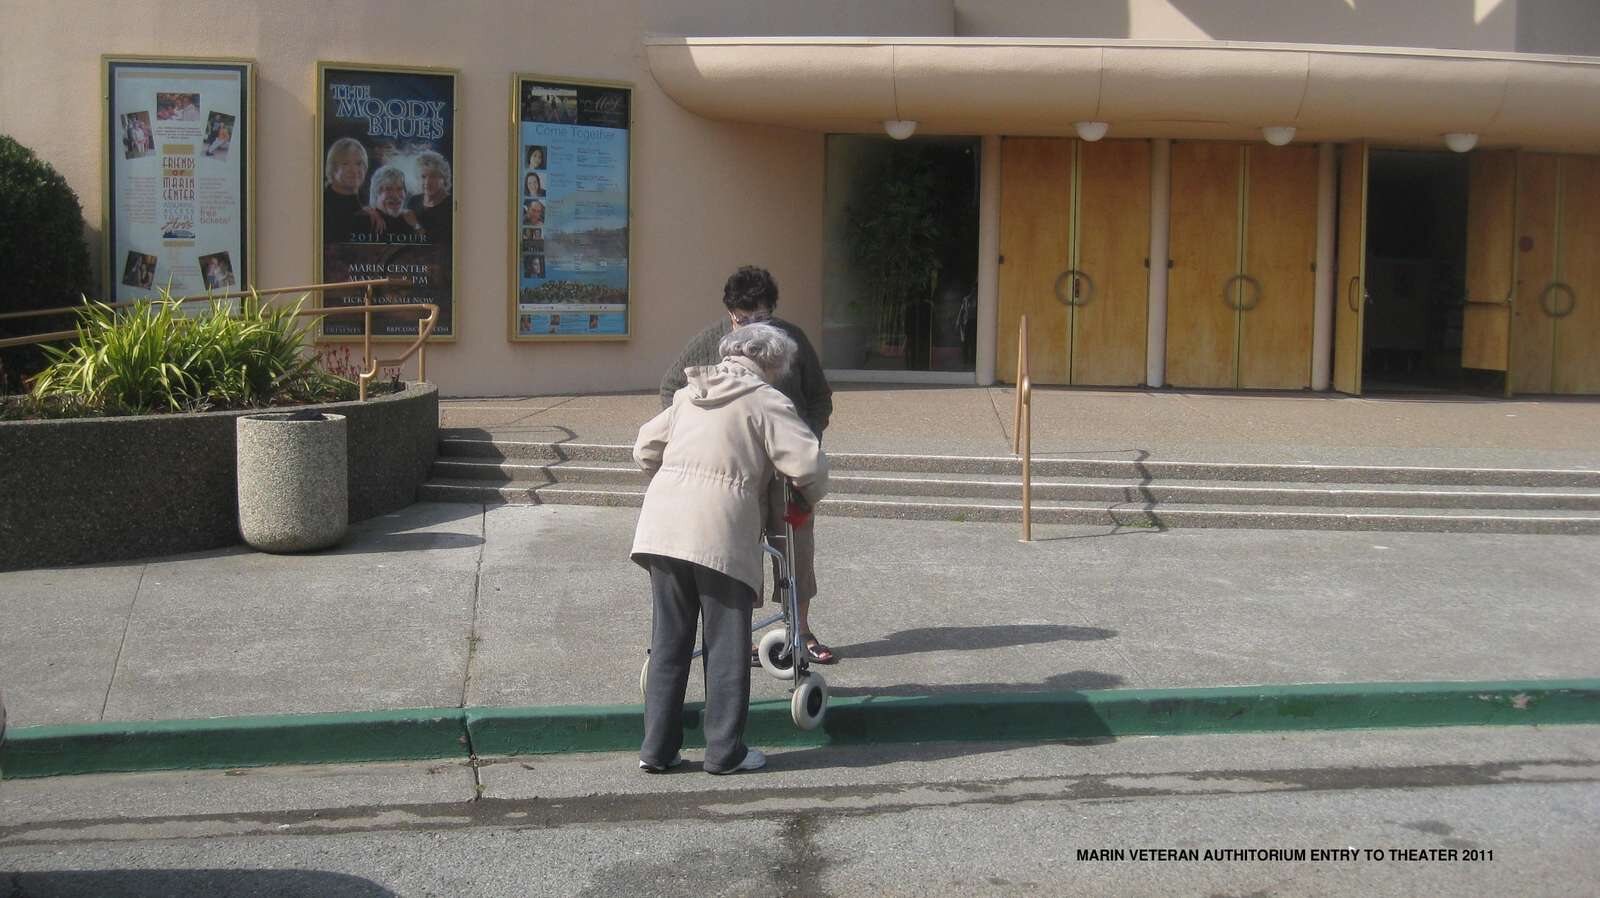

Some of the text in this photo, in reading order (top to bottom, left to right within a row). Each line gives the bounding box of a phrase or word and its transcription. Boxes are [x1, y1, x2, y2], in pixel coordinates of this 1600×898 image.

[330, 83, 371, 100] THE
[336, 98, 446, 120] MOODY
[367, 116, 445, 140] BLUES
[535, 124, 568, 136] Come
[162, 156, 196, 168] FRIENDS
[163, 176, 195, 188] MARIN
[162, 188, 195, 201] CENTER
[351, 232, 428, 242] 2011 TOUR
[348, 263, 429, 273] MARIN CENTER
[411, 296, 434, 304] NOW
